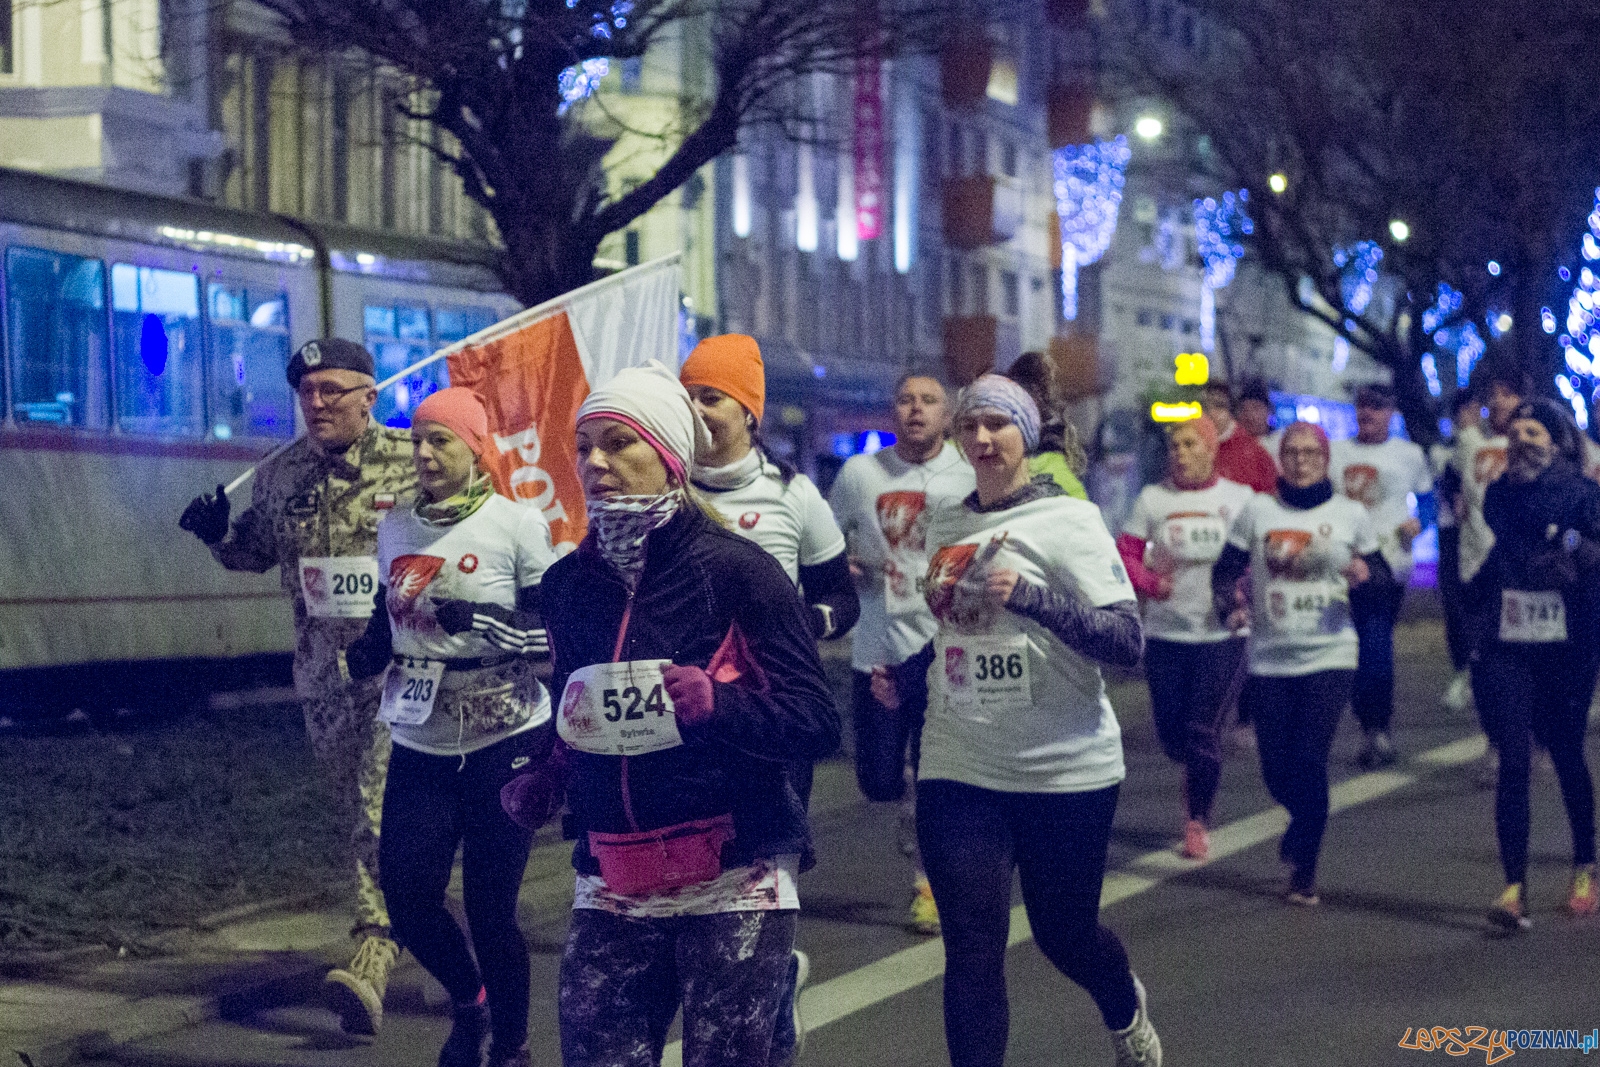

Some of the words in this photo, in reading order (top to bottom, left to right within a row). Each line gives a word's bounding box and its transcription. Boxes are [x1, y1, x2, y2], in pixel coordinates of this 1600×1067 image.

[332, 573, 373, 595] 209
[975, 653, 1023, 680] 386
[401, 678, 434, 702] 203
[603, 683, 666, 722] 524
[620, 727, 655, 739] Sylwia
